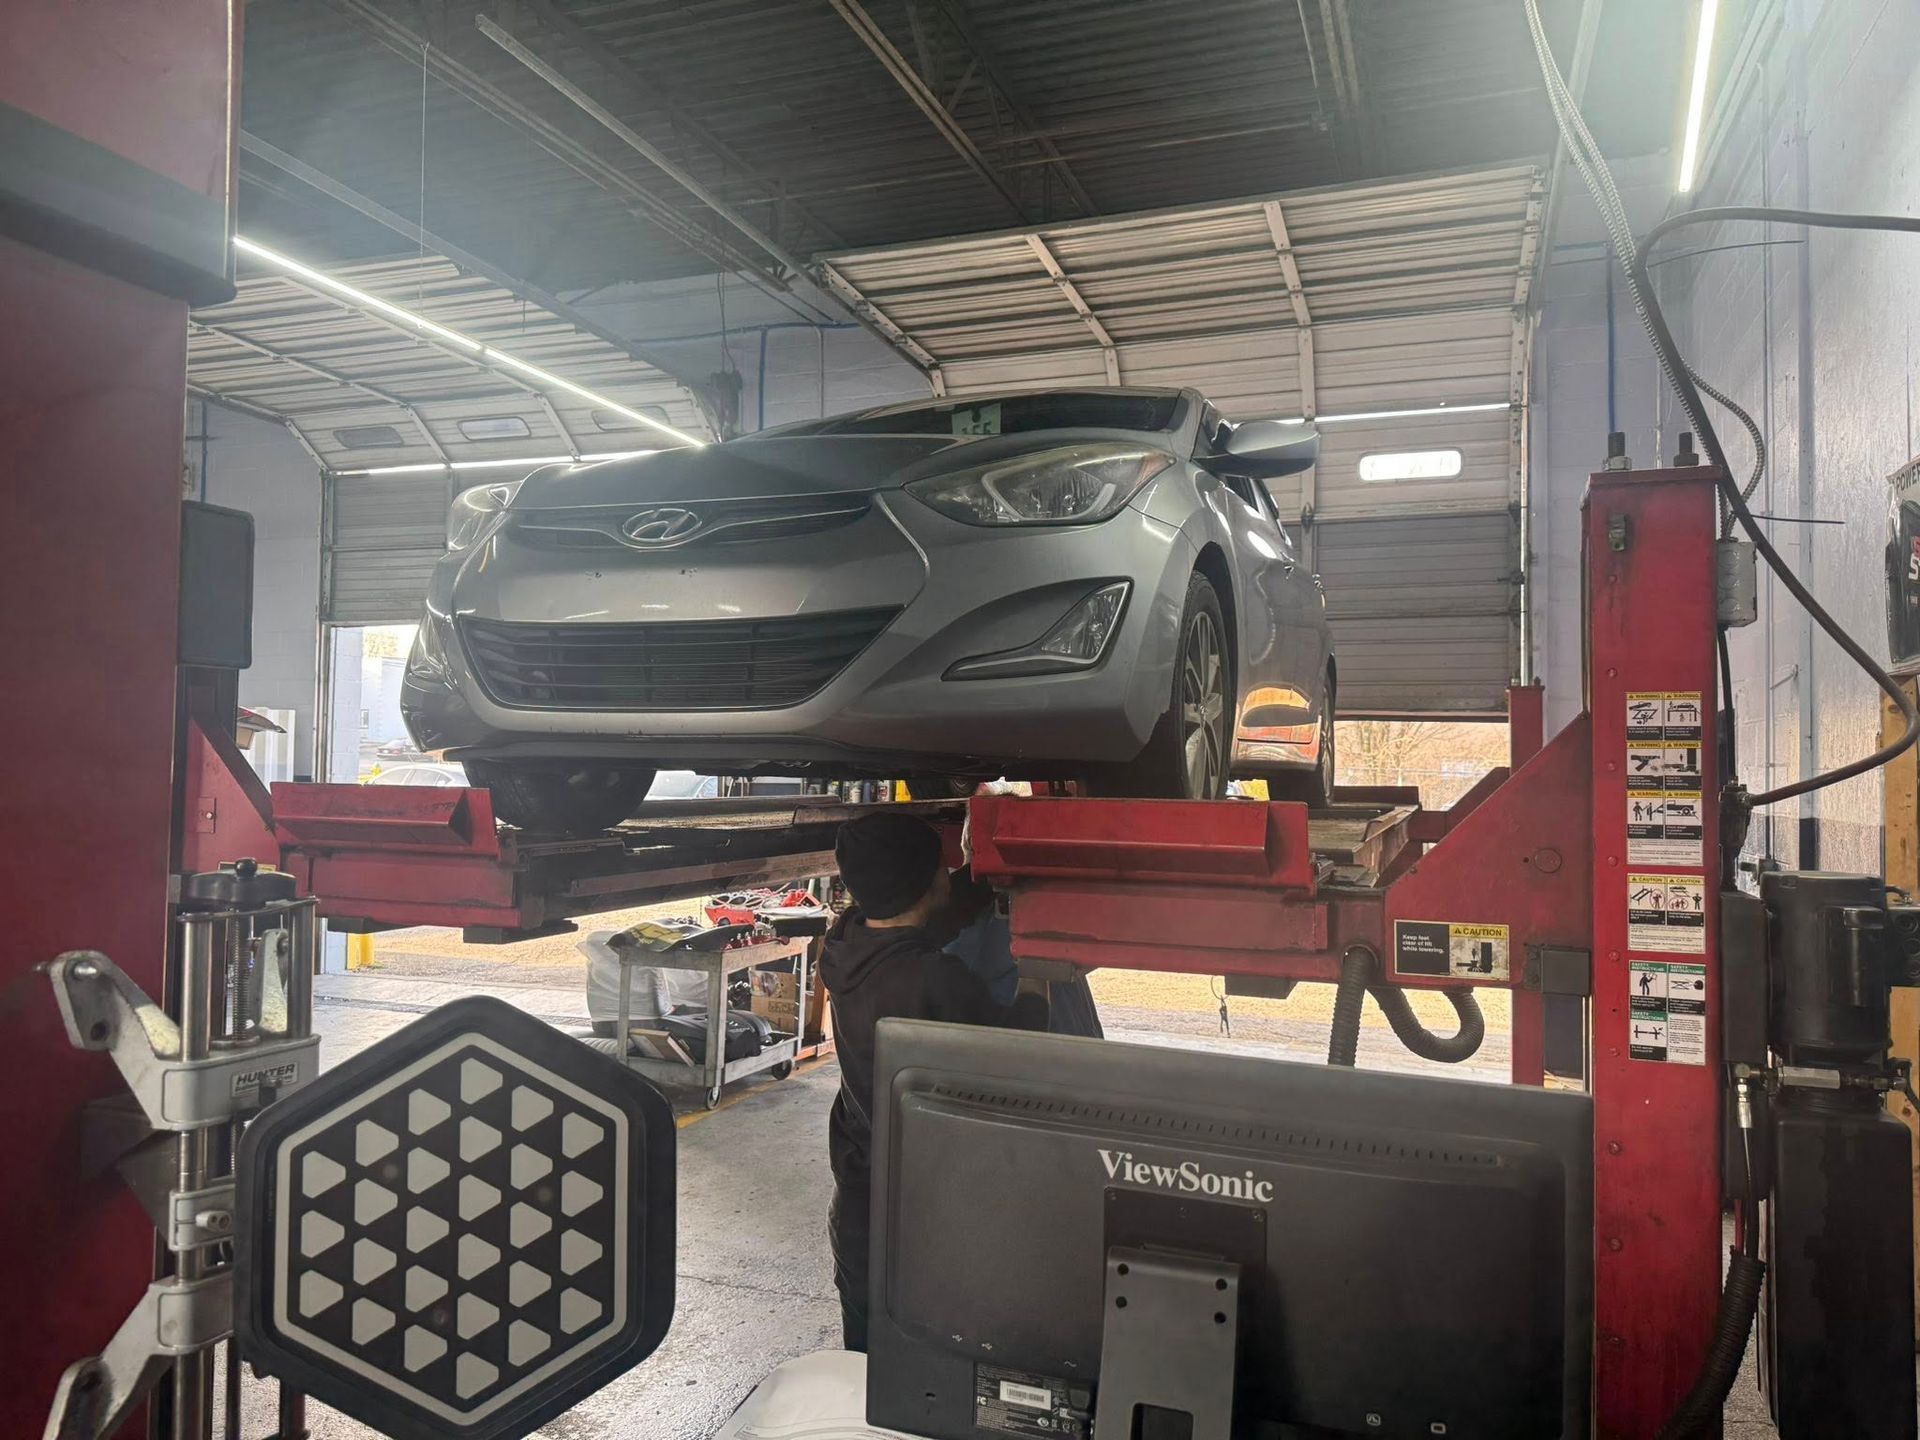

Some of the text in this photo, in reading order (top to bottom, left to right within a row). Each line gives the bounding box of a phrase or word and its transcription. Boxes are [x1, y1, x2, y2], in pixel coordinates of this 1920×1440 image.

[1463, 927, 1502, 936] CAUTION
[236, 1063, 295, 1086] HUNTER
[1097, 1149, 1274, 1202] ViewSonic
